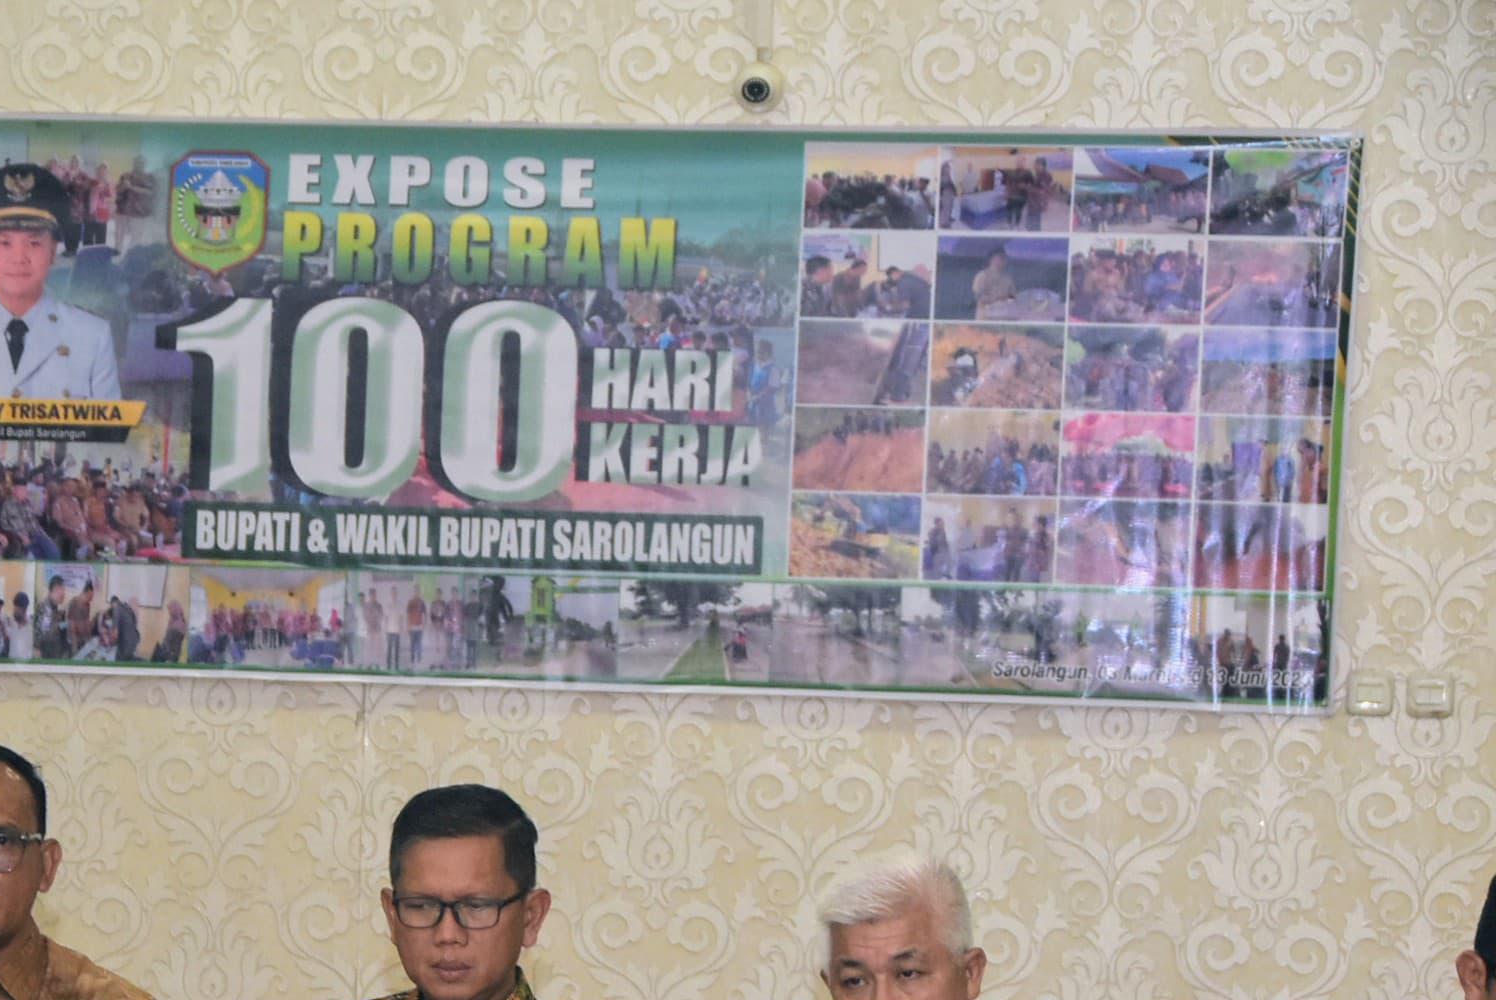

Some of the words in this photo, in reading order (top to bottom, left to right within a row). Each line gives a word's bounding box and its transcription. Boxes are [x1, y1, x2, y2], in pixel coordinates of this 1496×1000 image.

[287, 153, 596, 209] EXPOSE
[282, 211, 679, 288] PROGRAM
[176, 297, 579, 501] 100
[591, 347, 732, 411] HARI
[6, 427, 34, 438] Bupati
[37, 428, 86, 440] Sarolangun
[9, 402, 122, 421] TRISATWIKA
[588, 422, 762, 486] KERJA
[195, 509, 301, 553] BUPATI
[307, 521, 329, 554] &
[336, 513, 433, 557] WAKIL
[439, 515, 546, 561] BUPATI
[552, 518, 756, 565] SAROLANGUN
